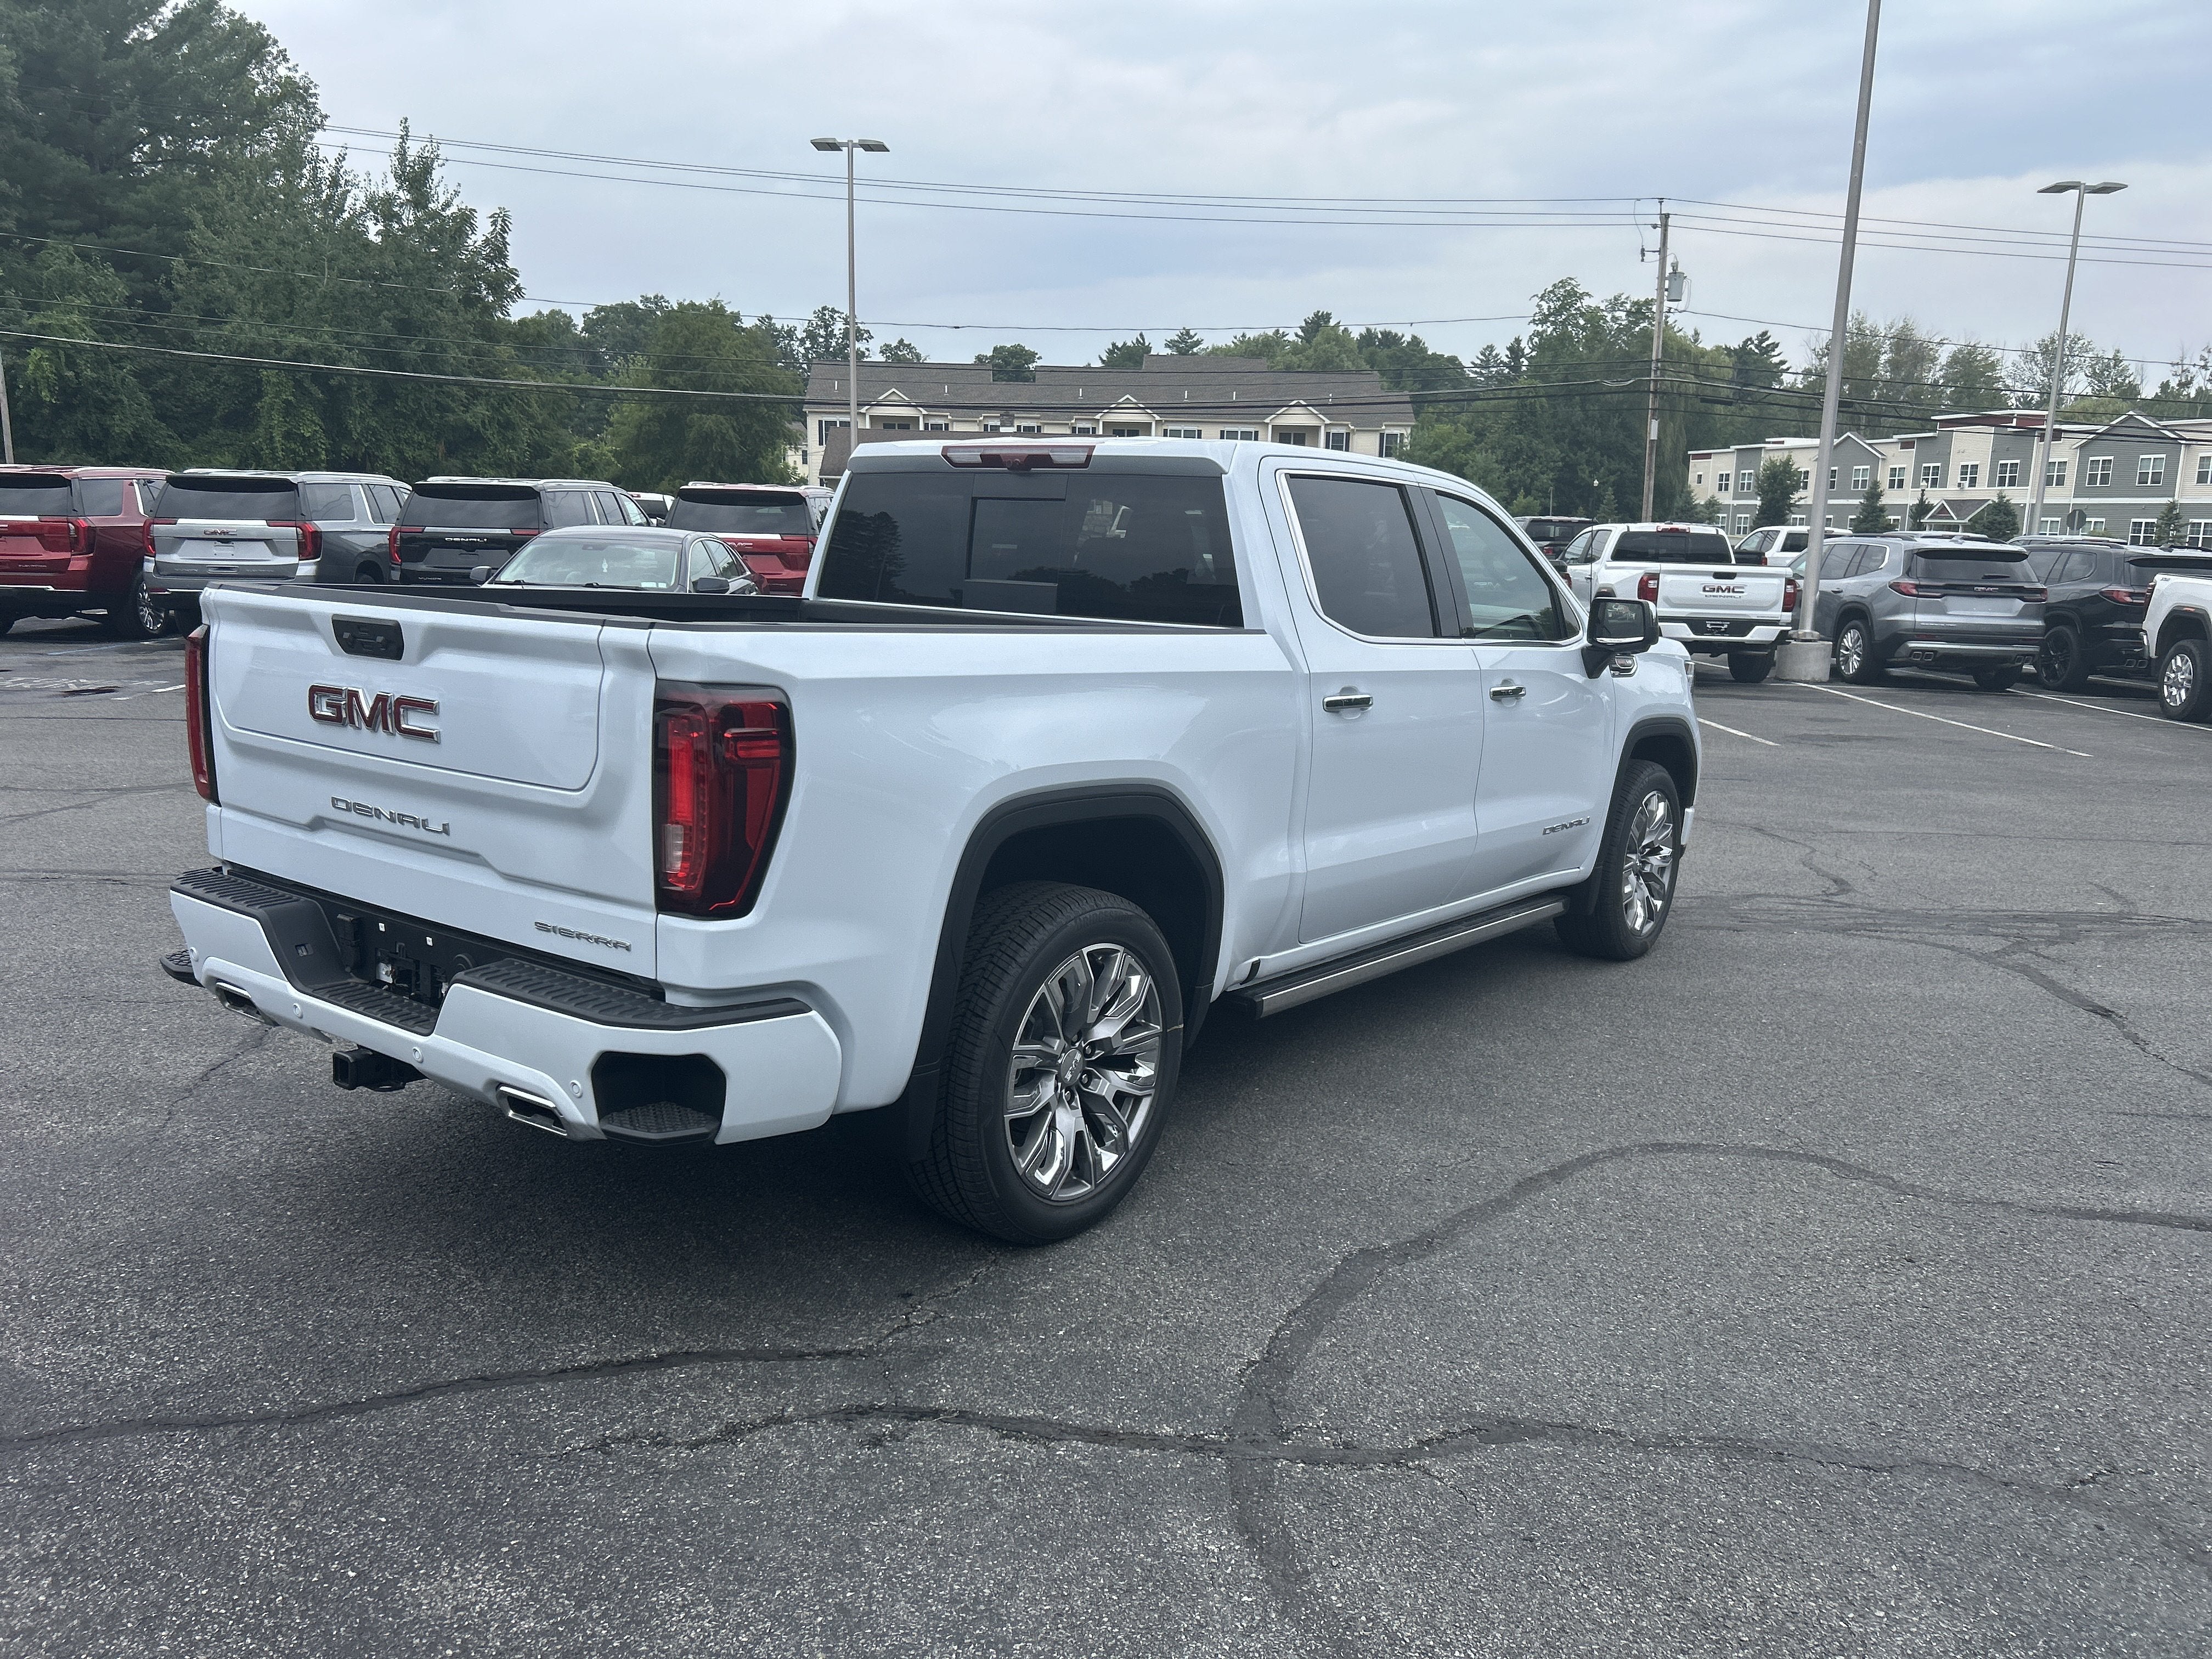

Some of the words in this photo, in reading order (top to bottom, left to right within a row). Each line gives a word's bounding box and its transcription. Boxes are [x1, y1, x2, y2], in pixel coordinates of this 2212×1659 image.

[1702, 585, 1745, 594] GMC
[308, 683, 441, 744] GMC
[331, 795, 450, 836] DENALI
[1542, 816, 1590, 836] DENALI
[534, 921, 632, 952] SIERRA
